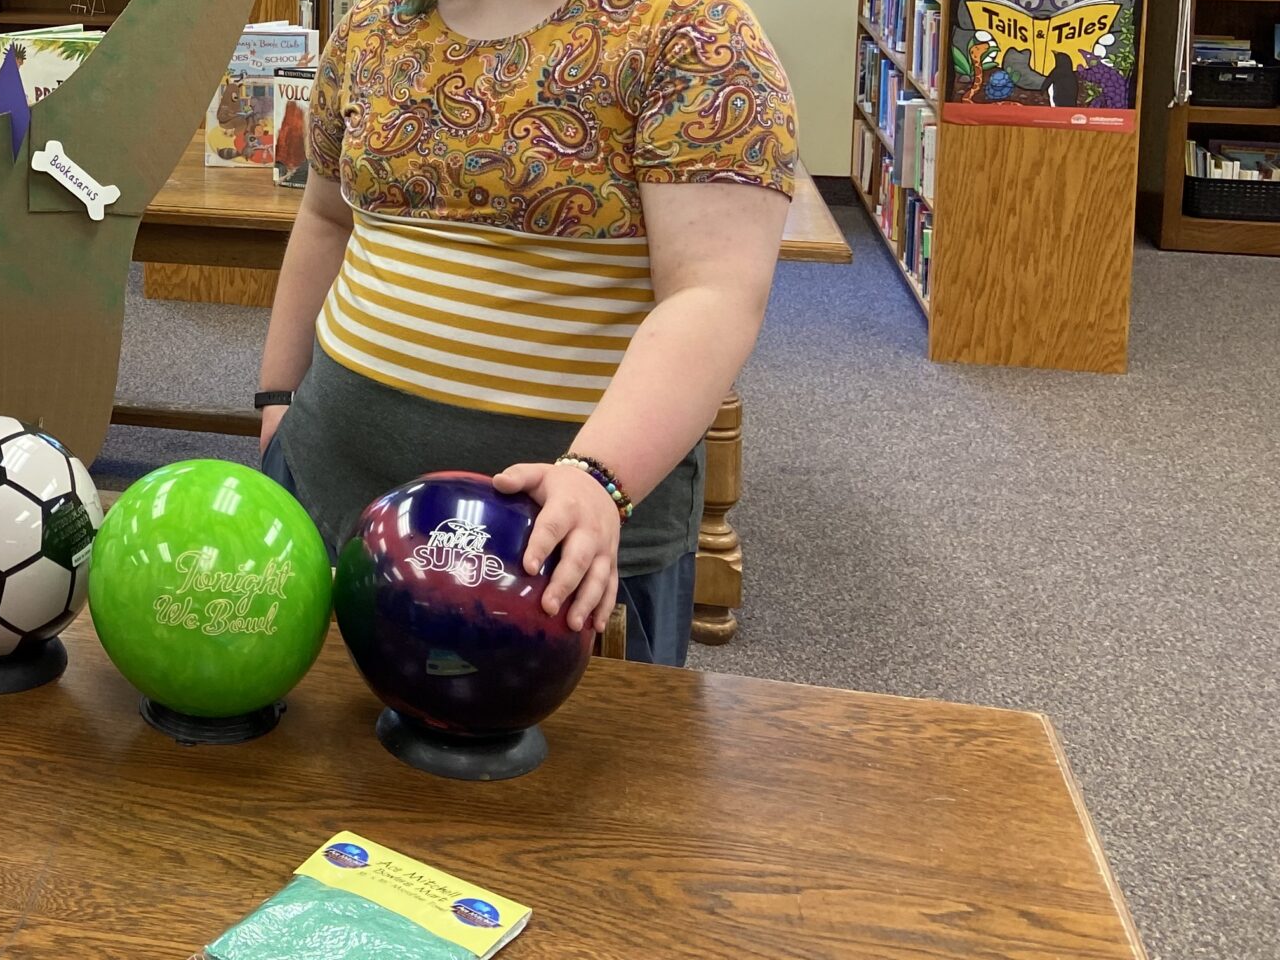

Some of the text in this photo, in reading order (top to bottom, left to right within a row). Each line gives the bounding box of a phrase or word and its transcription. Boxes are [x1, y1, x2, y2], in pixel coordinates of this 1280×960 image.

[982, 7, 1109, 44] Tails & Tales
[231, 54, 299, 68] OES TO SCHOOL
[280, 40, 300, 49] Club
[278, 83, 311, 102] VOLC
[49, 154, 99, 201] Bookasarus
[175, 550, 295, 617] Tonight
[153, 595, 200, 629] We
